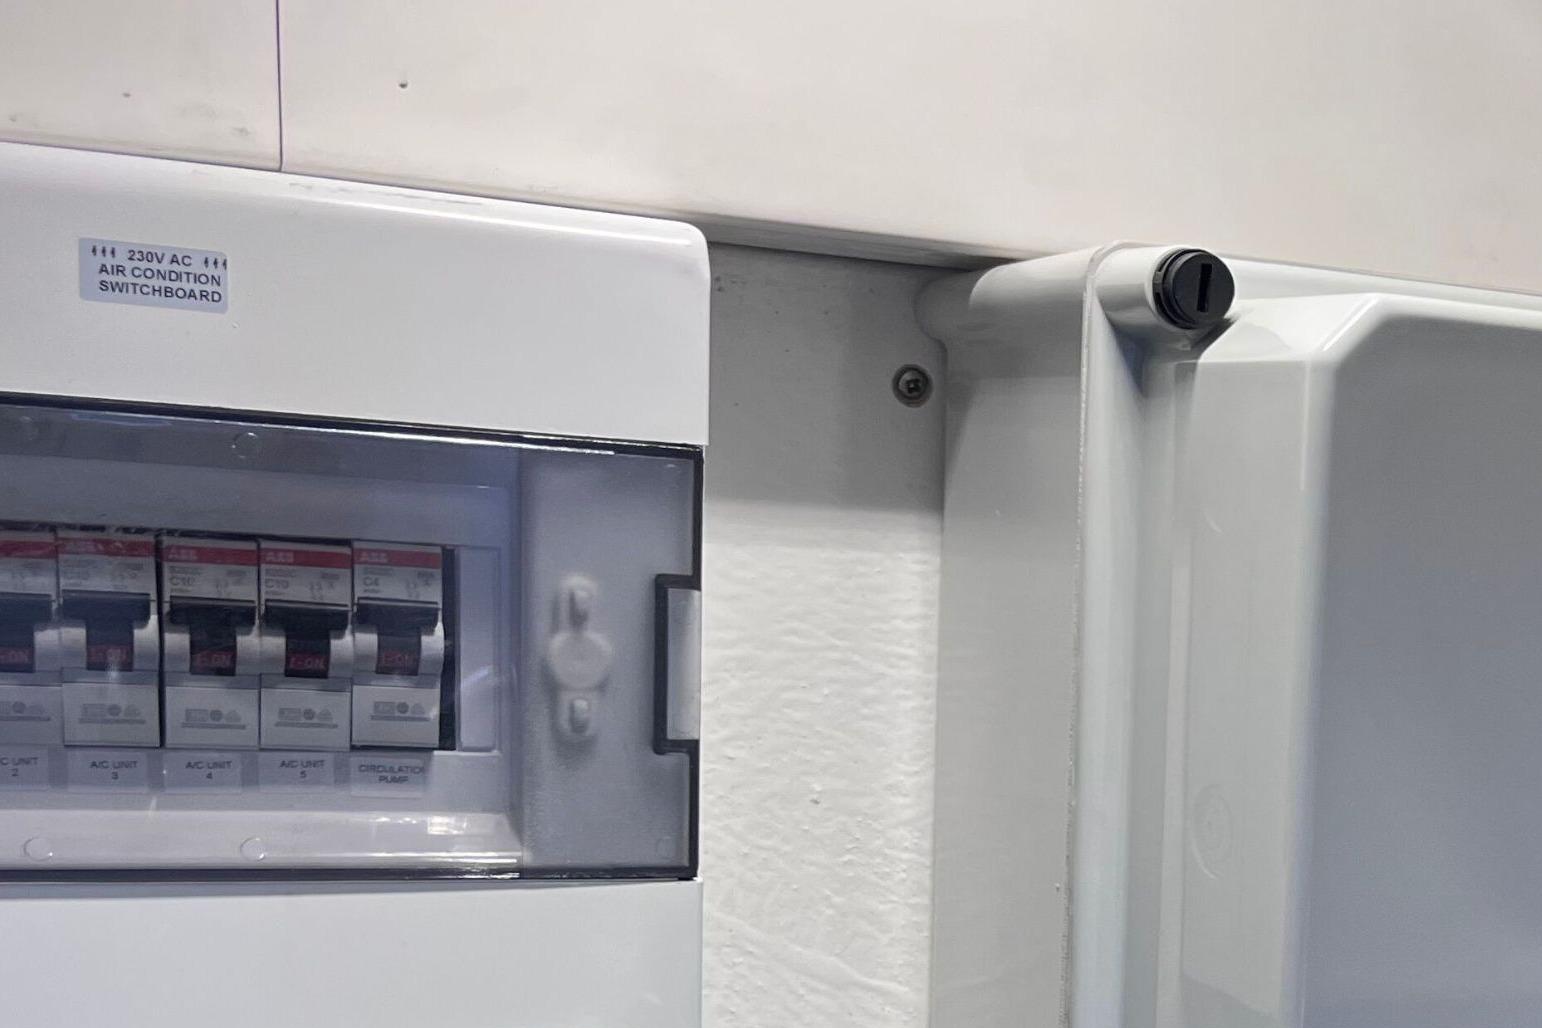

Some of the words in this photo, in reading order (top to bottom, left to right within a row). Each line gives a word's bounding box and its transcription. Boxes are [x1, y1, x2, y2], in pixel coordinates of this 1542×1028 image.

[127, 249, 165, 264] 230V
[169, 254, 192, 267] AC
[98, 263, 127, 278] AIR
[131, 266, 222, 287] CONDITION
[98, 280, 223, 303] SWITCHBOARD
[11, 768, 19, 777] 2
[111, 772, 119, 780] 3
[206, 772, 213, 780] 4
